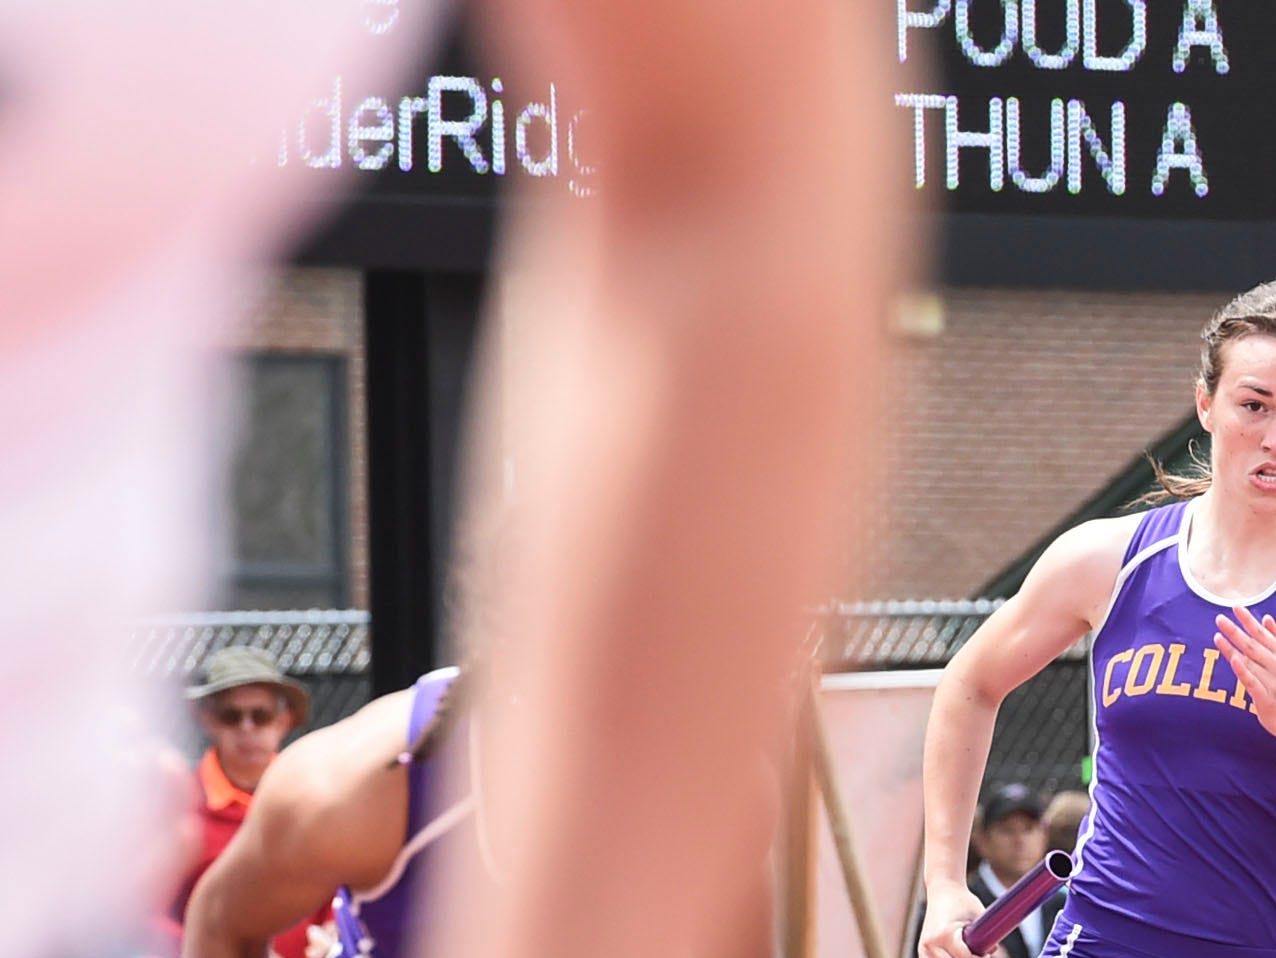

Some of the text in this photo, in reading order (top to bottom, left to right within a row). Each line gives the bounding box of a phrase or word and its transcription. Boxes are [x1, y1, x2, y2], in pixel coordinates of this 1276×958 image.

[897, 0, 1230, 74] POUD A
[894, 94, 1209, 197] THUN A
